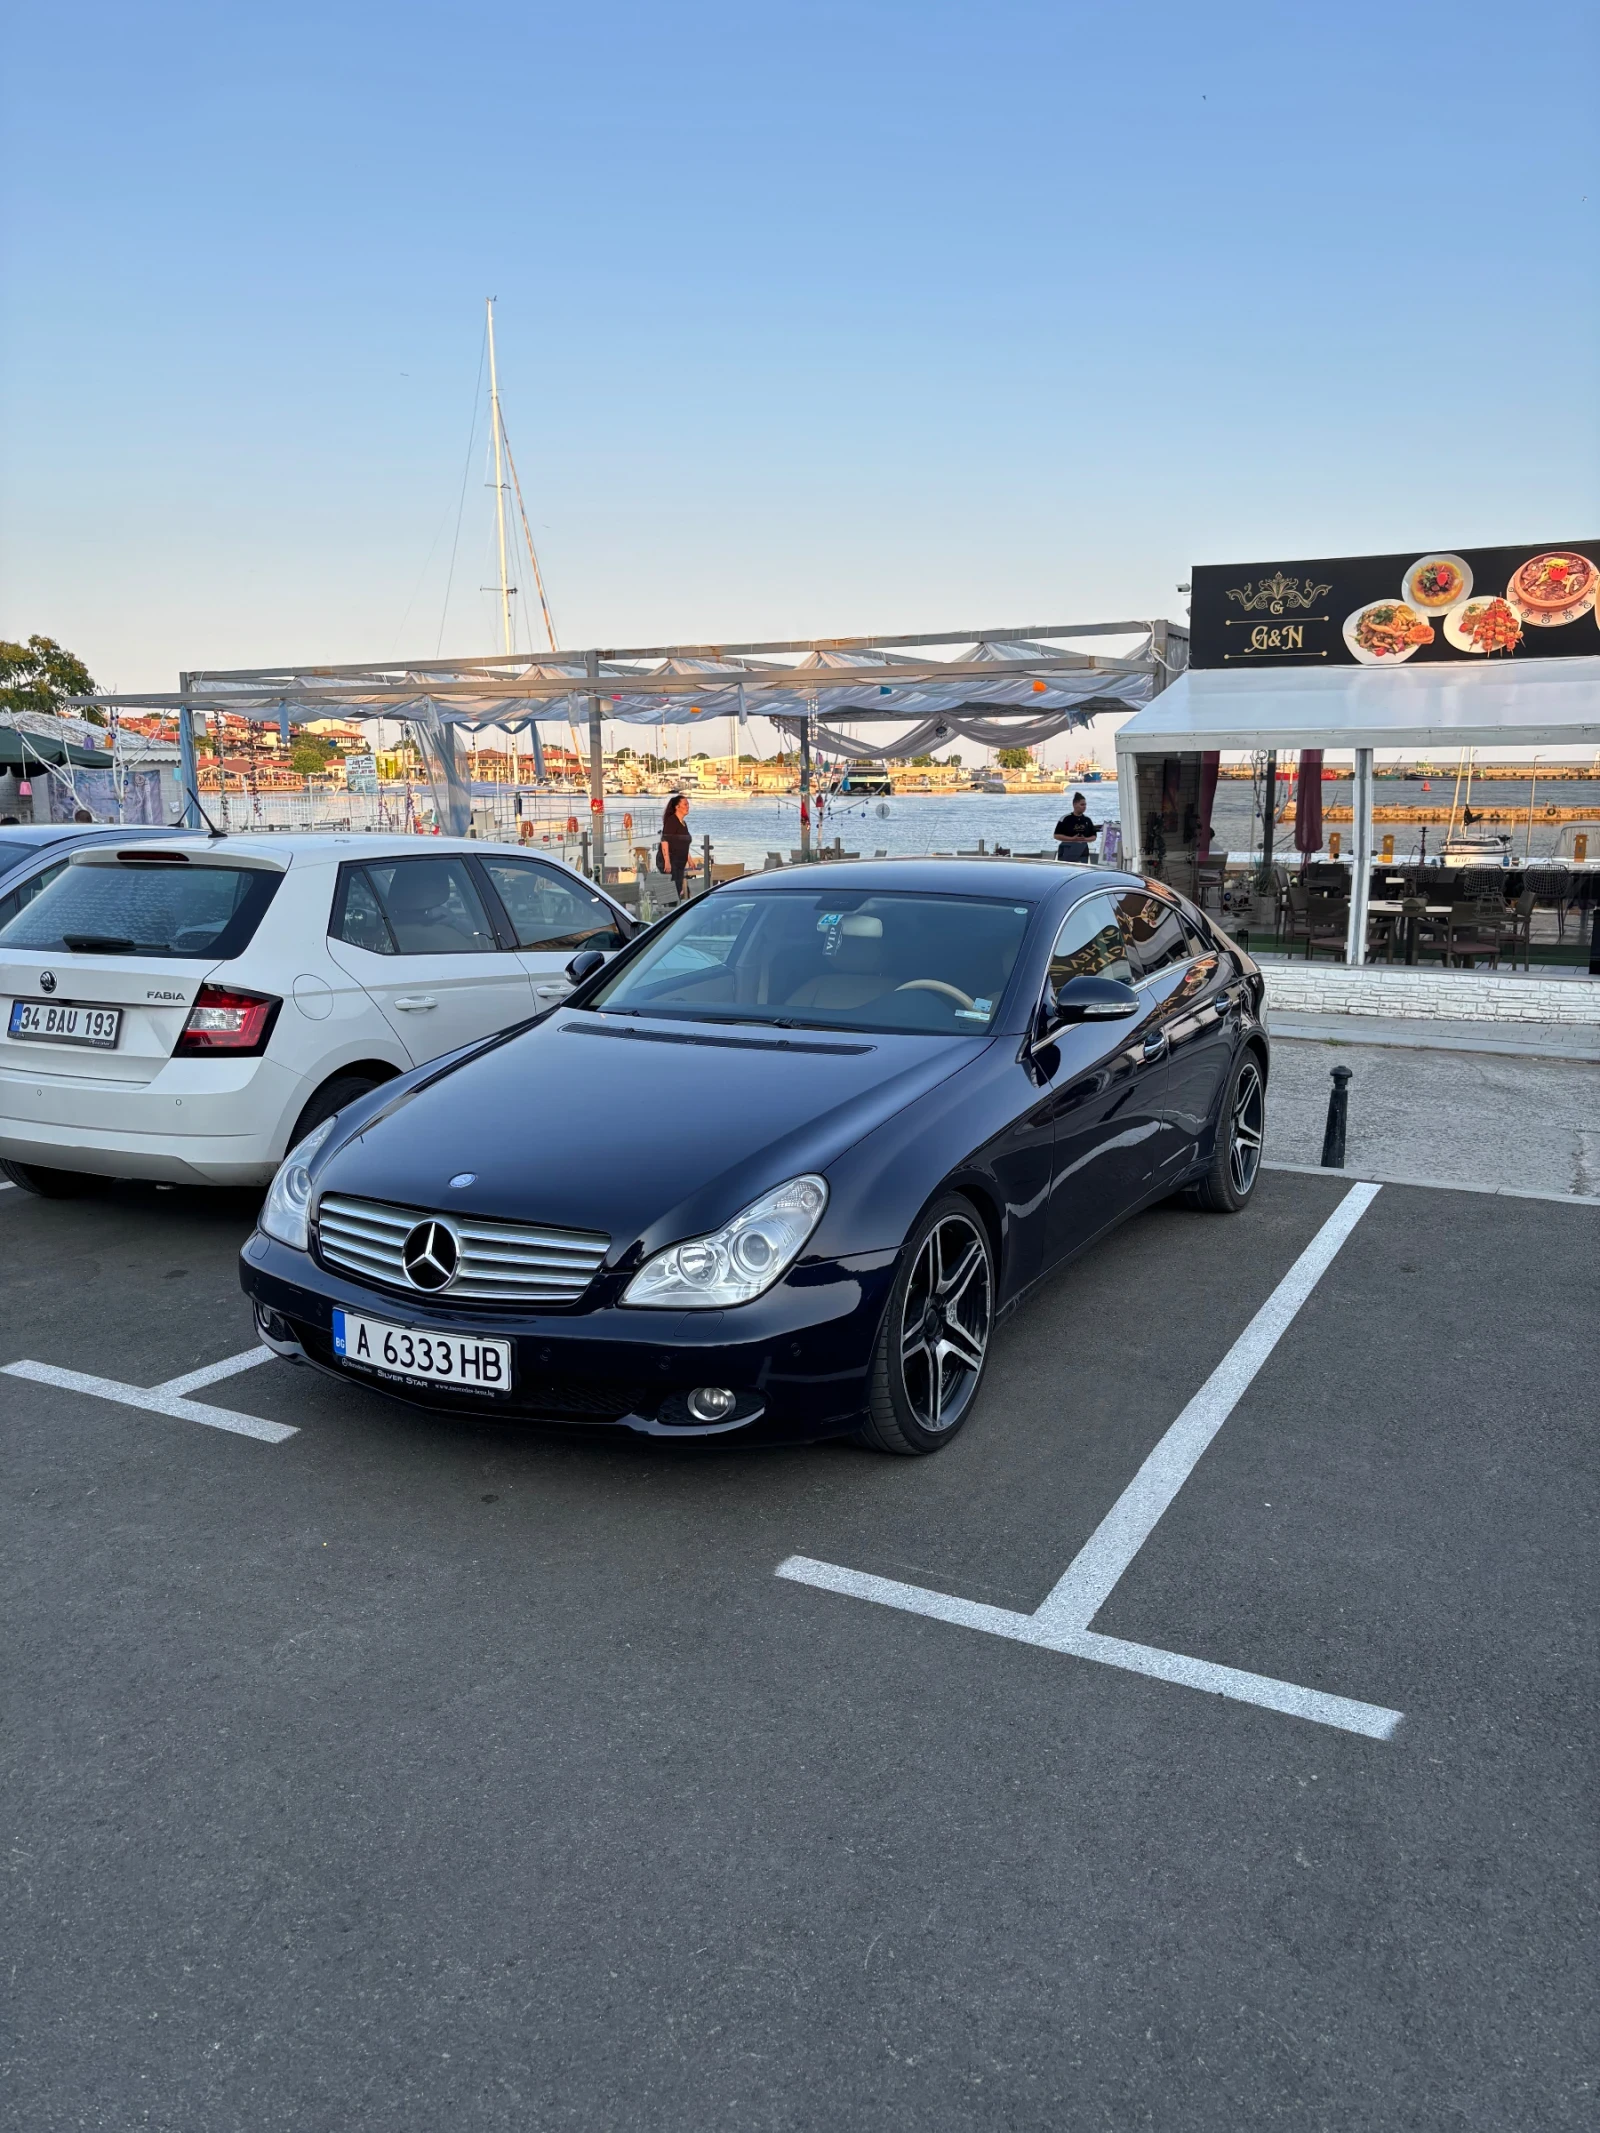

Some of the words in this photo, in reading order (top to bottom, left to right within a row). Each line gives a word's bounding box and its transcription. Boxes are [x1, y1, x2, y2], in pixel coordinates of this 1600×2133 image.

[1244, 625, 1303, 653] G&N
[147, 991, 185, 1001] FABIA
[21, 1007, 40, 1031] 34
[46, 1009, 78, 1033] BAU
[85, 1012, 115, 1037] 193
[335, 1337, 345, 1349] BG
[357, 1323, 371, 1358] A
[384, 1331, 453, 1375] 6333
[460, 1344, 502, 1382] HB
